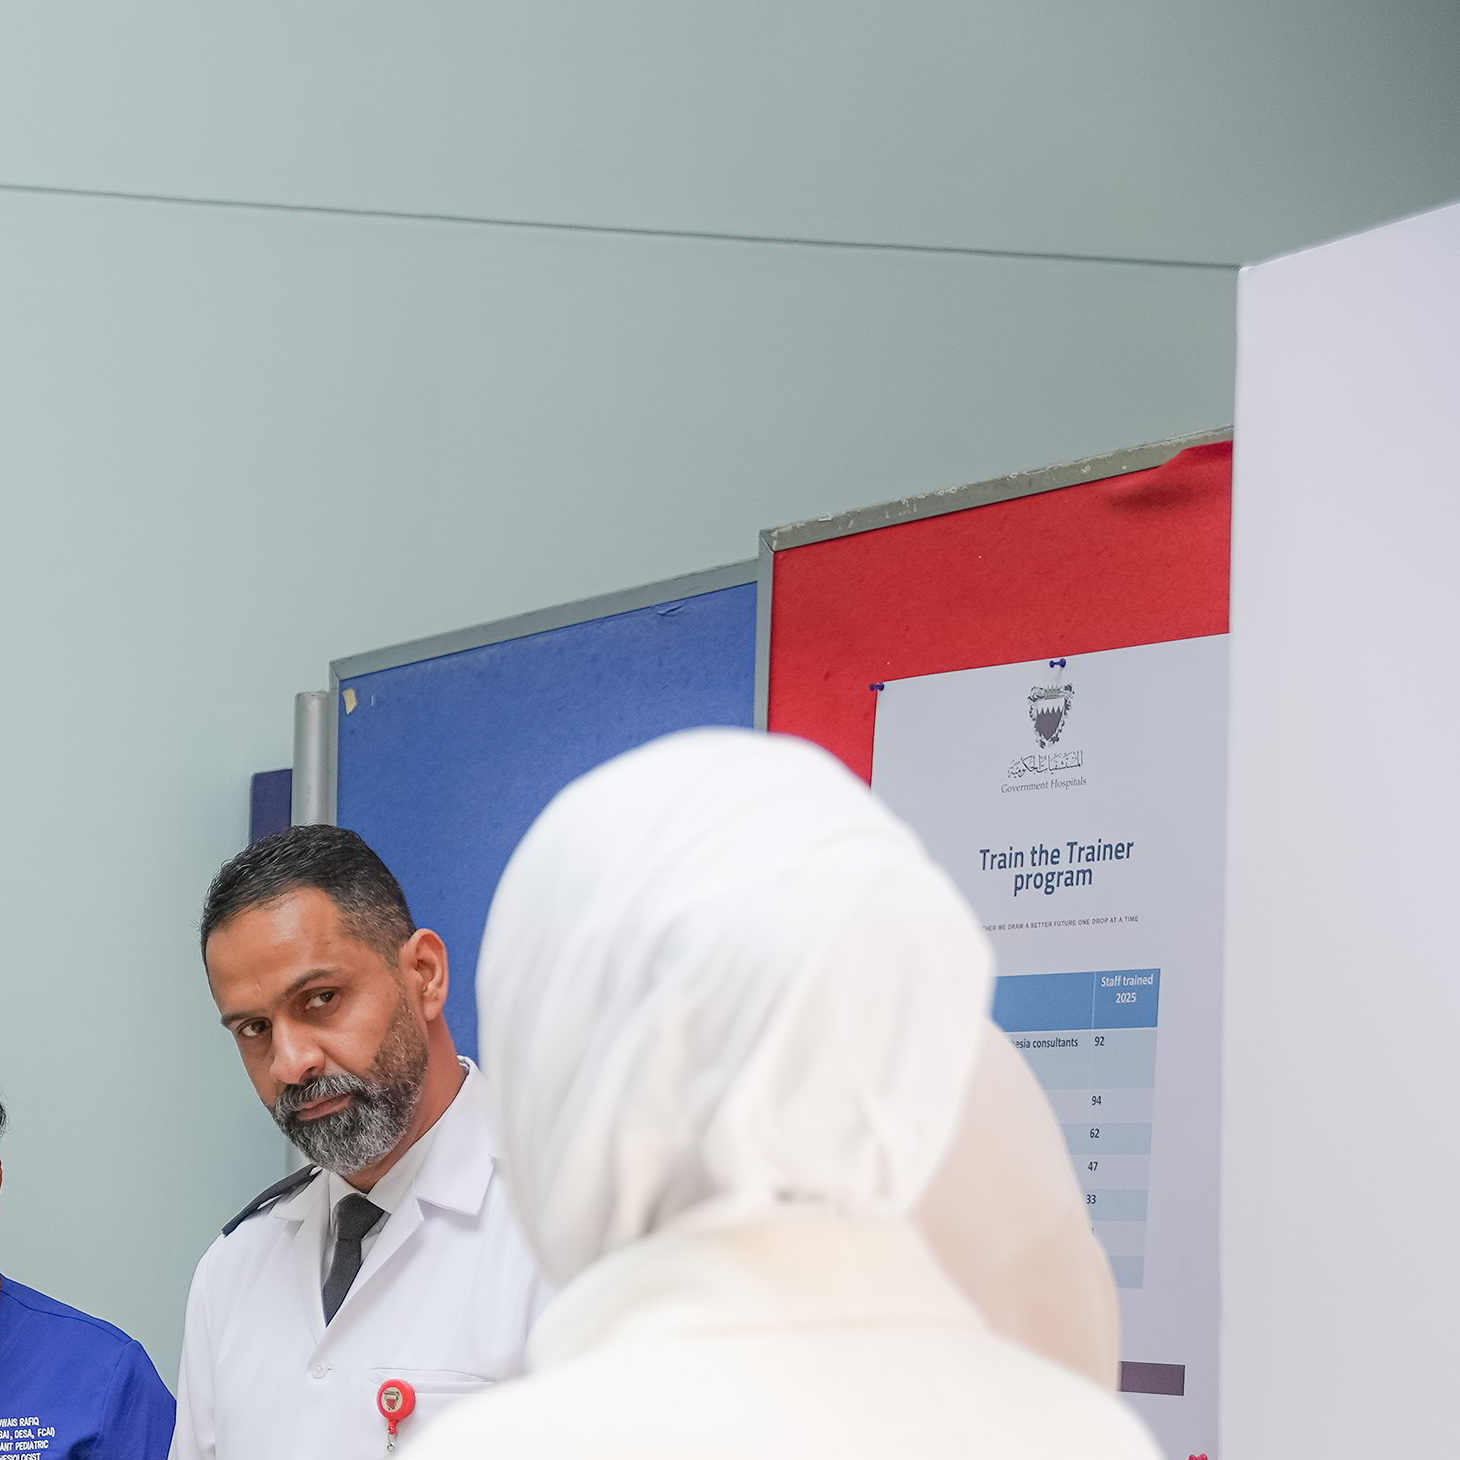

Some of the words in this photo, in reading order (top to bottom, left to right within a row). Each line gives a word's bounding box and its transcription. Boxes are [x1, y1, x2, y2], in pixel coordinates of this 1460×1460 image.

[1001, 781, 1049, 793] Government
[1050, 776, 1087, 790] Hospitals
[980, 846, 1024, 871] Train
[1030, 844, 1061, 867] the
[1066, 838, 1134, 864] Trainer
[1013, 867, 1093, 897] program
[1101, 975, 1121, 987] Staff
[1122, 973, 1154, 986] trained
[1115, 992, 1137, 1003] 2025
[1014, 1038, 1030, 1048] esia
[1032, 1037, 1079, 1048] consultants
[1094, 1036, 1105, 1046] 92
[1091, 1095, 1102, 1105] 94
[1089, 1128, 1100, 1139] 62
[1087, 1162, 1098, 1171] 47
[1086, 1194, 1097, 1204] 33
[19, 1416, 40, 1426] RAFIQ
[15, 1440, 49, 1451] PEDIATRIC
